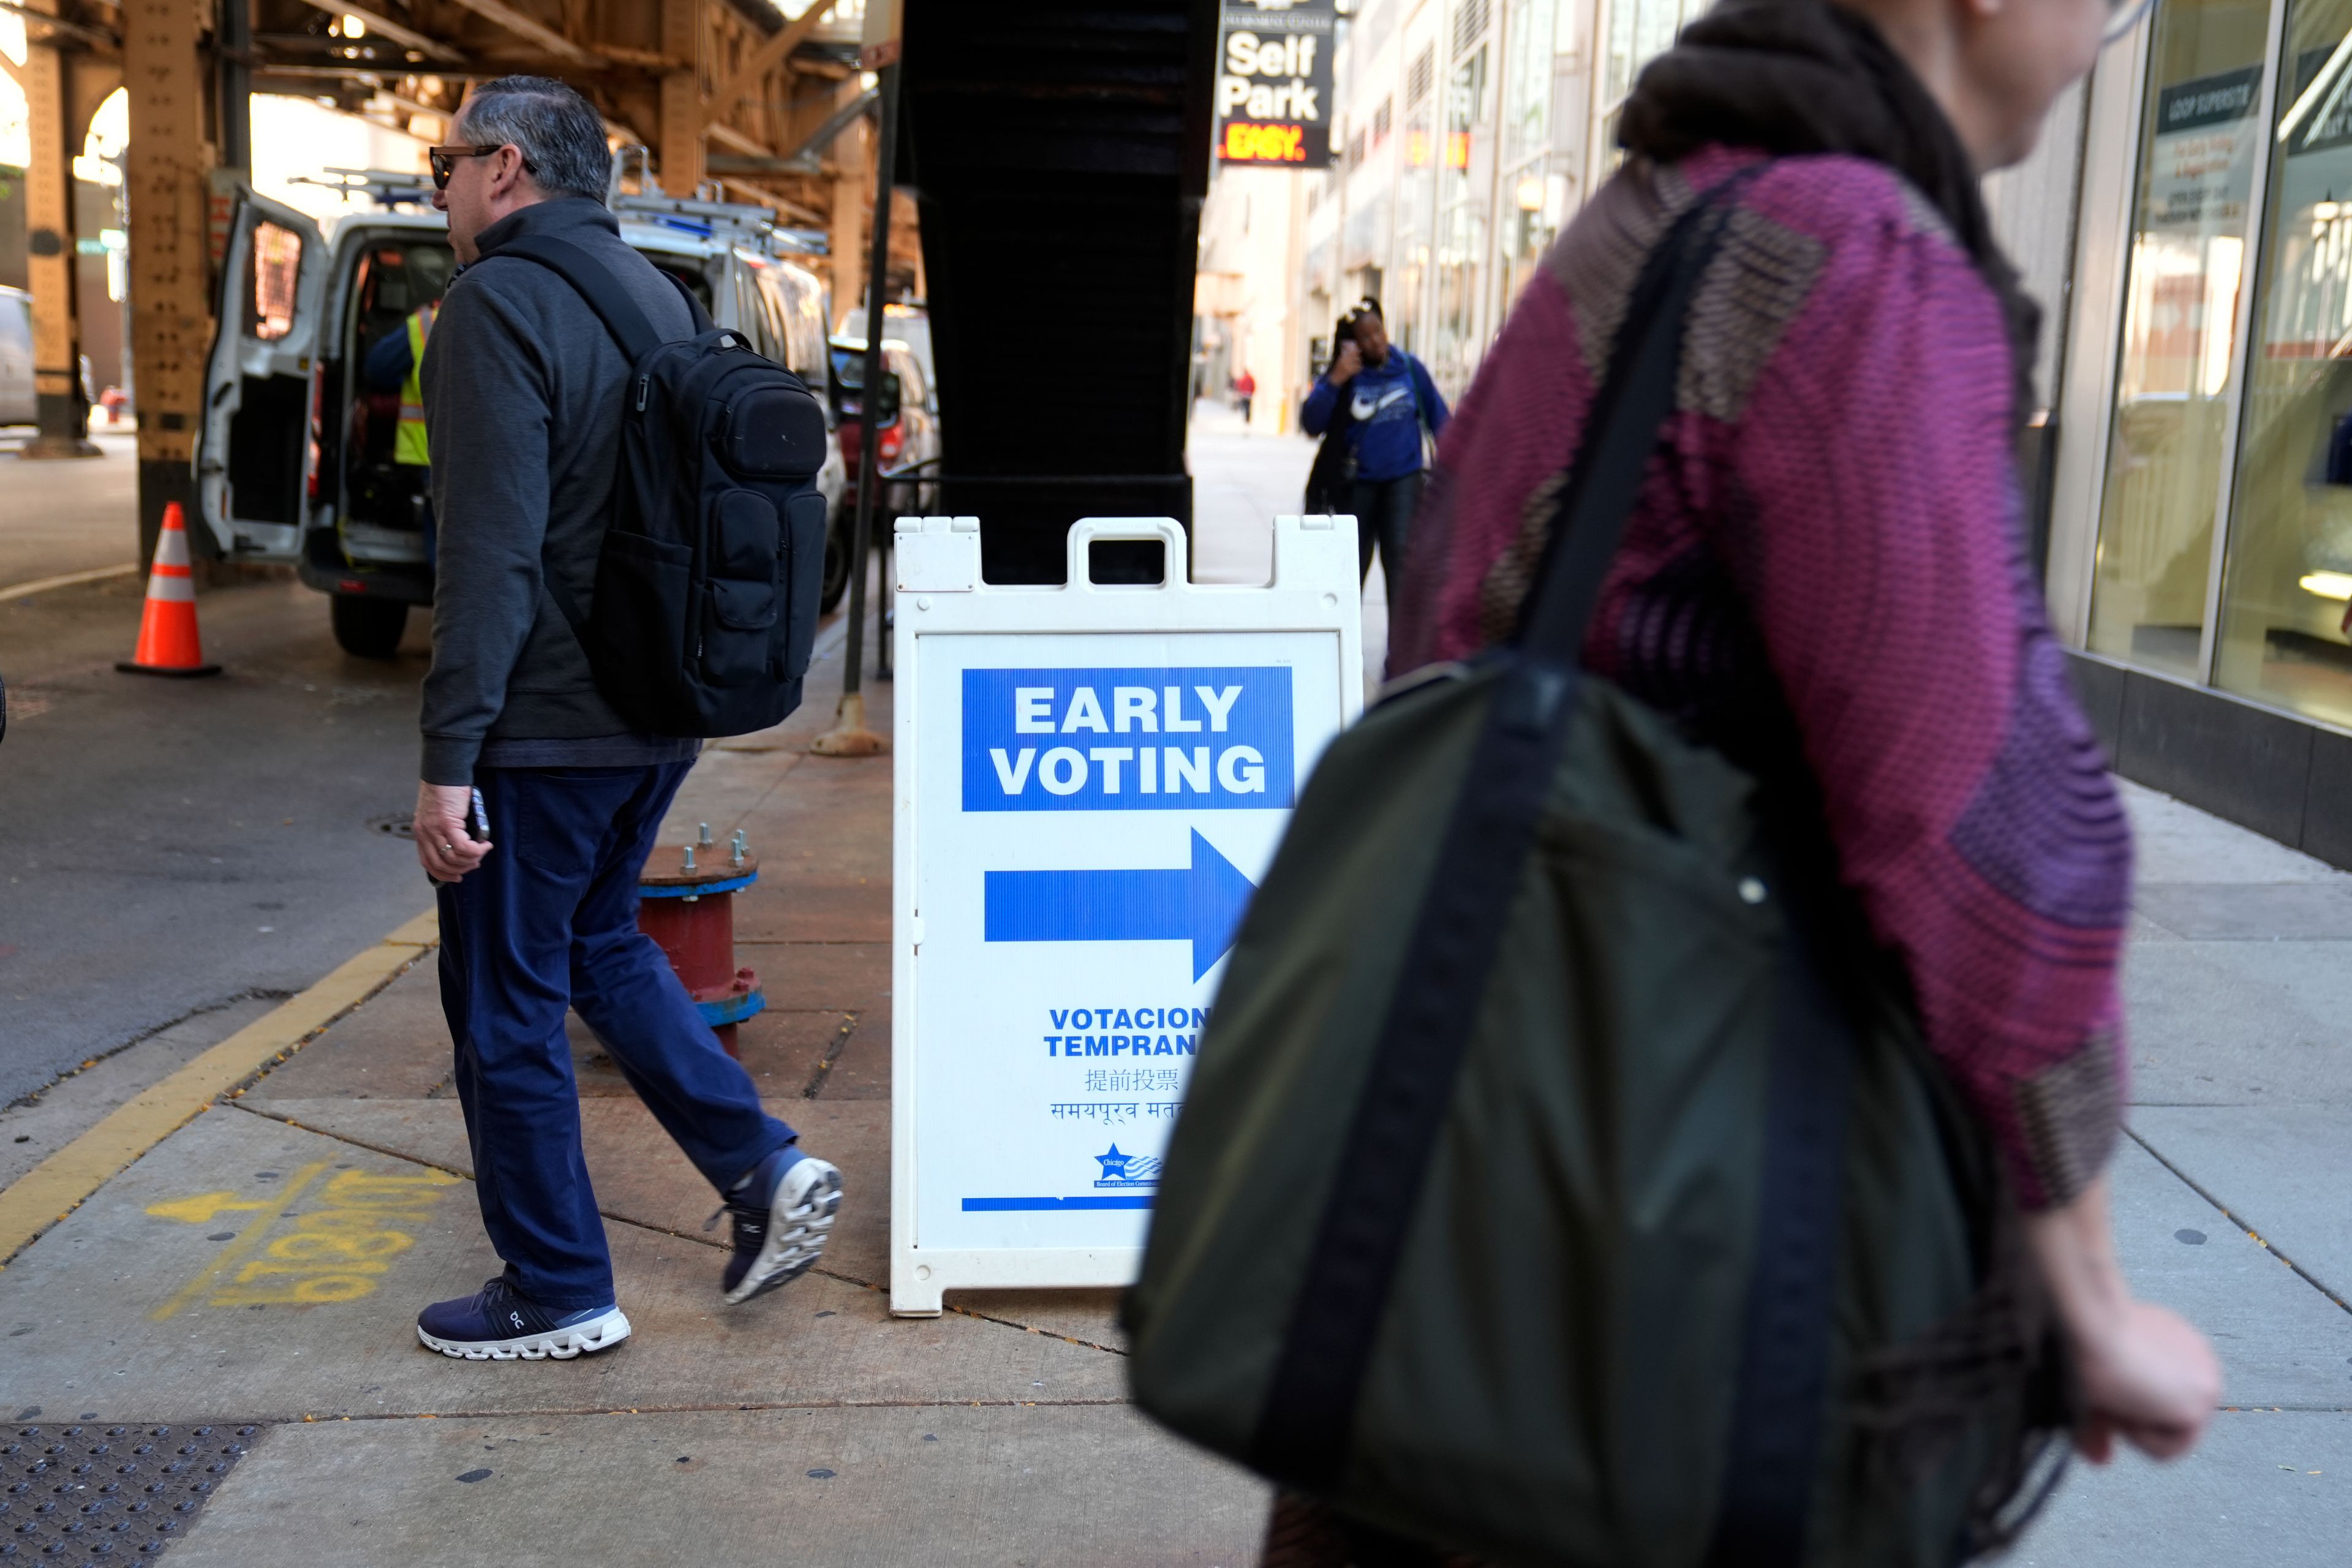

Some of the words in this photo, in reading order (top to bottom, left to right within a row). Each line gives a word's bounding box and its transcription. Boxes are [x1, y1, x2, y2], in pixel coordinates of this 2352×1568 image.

[1226, 31, 1317, 78] Self
[1219, 75, 1319, 121] Park
[1015, 686, 1243, 733] EARLY
[989, 745, 1265, 796] VOTING
[1049, 1008, 1212, 1030] VOTACION
[1044, 1035, 1196, 1057] TEMPRAN
[1085, 1069, 1178, 1091] 提前投票
